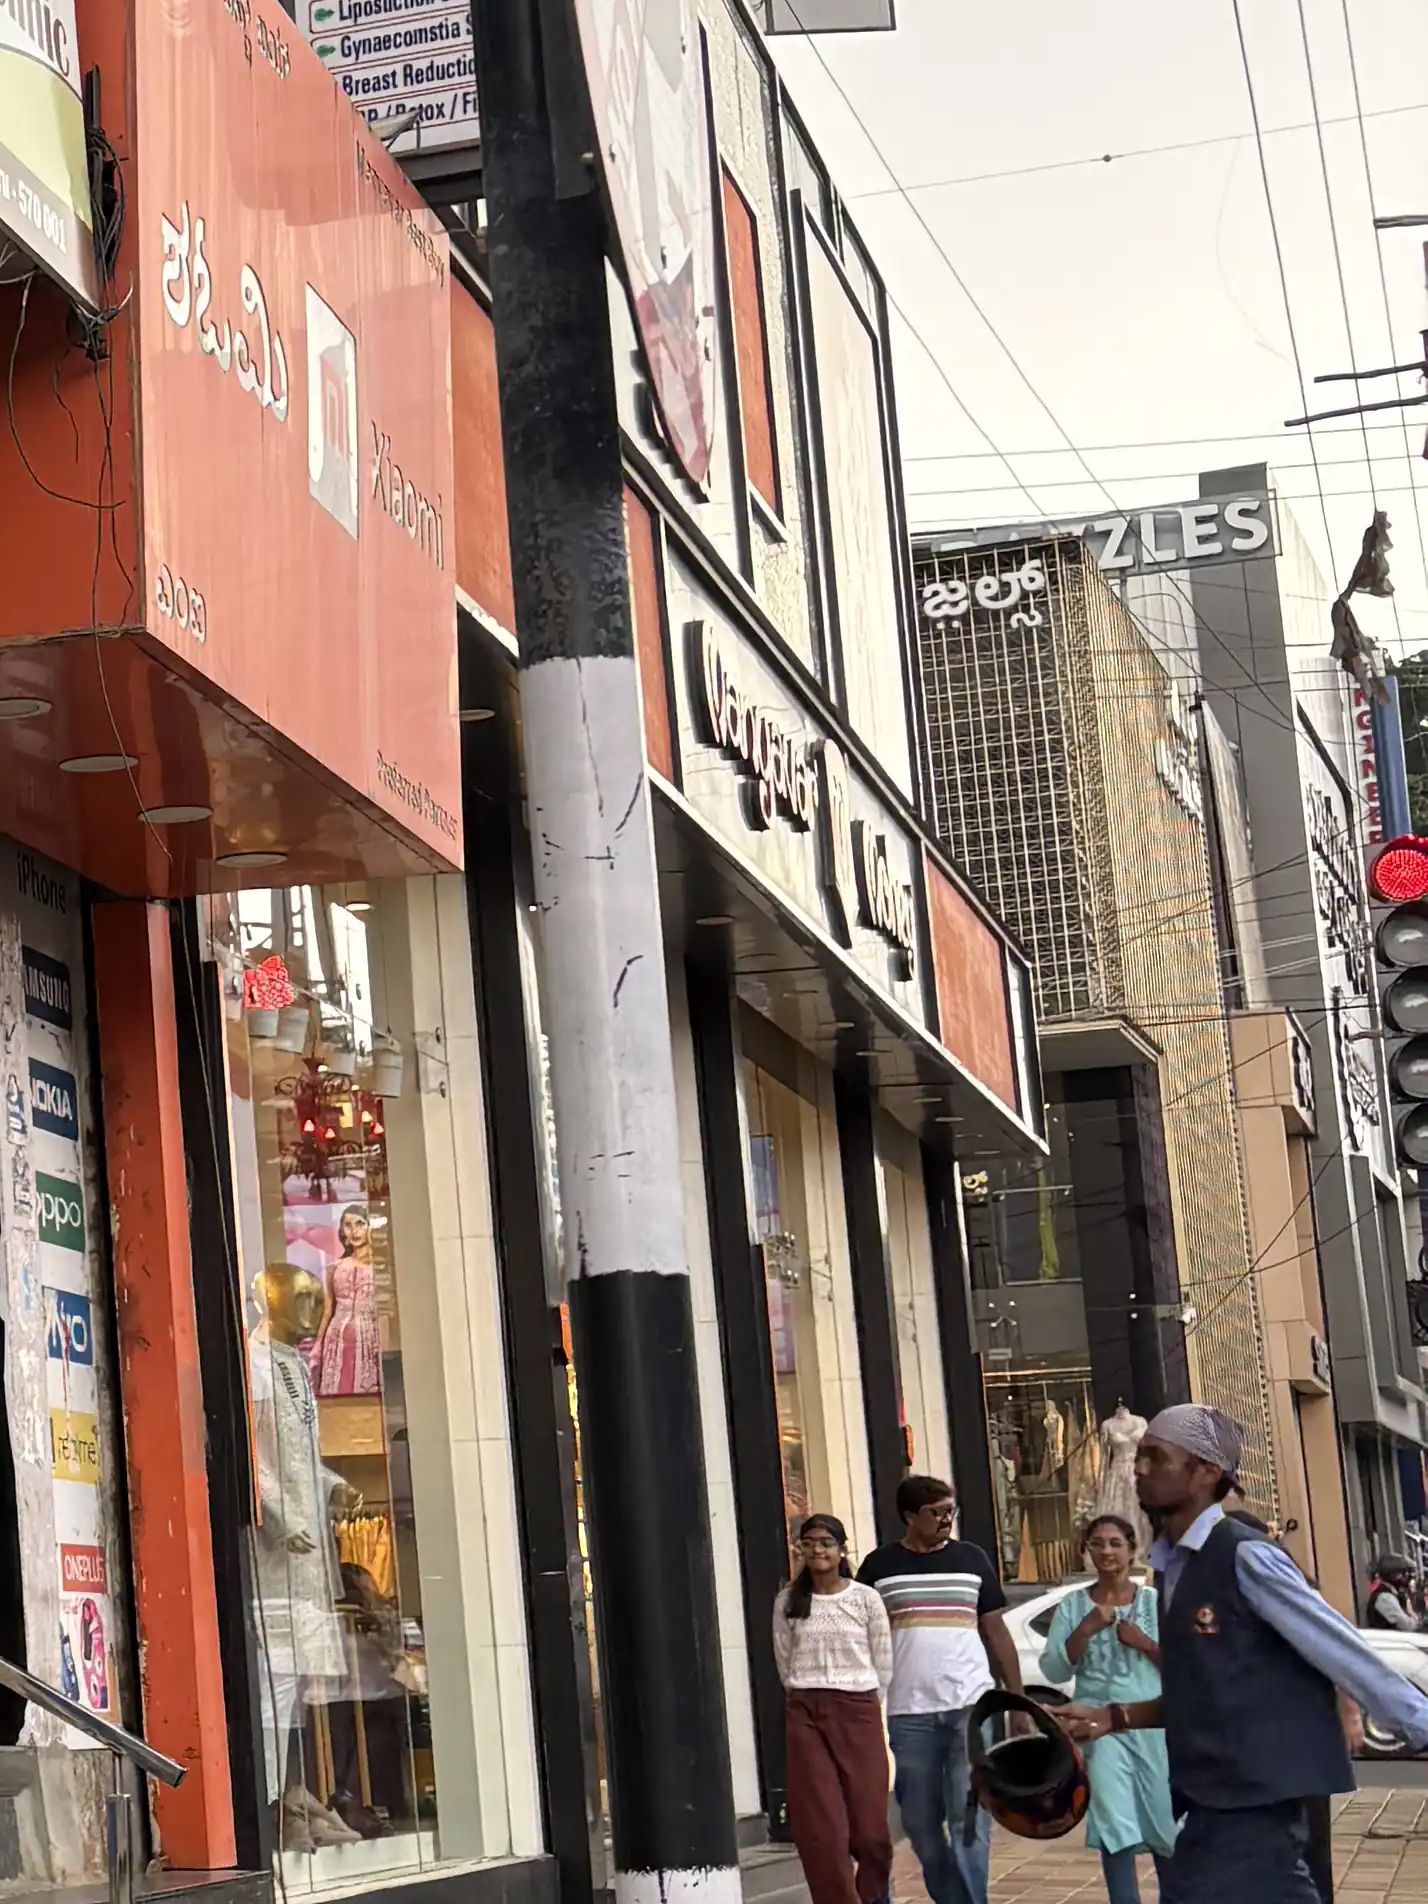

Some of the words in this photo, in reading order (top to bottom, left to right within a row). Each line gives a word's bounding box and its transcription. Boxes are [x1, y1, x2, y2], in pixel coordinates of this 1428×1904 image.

[340, 22, 461, 61] Gynaecomstia
[342, 68, 399, 98] Breast
[17, 180, 43, 235] 570
[43, 203, 67, 254] 001
[370, 418, 445, 571] Xiaomi
[17, 852, 67, 914] iPhone
